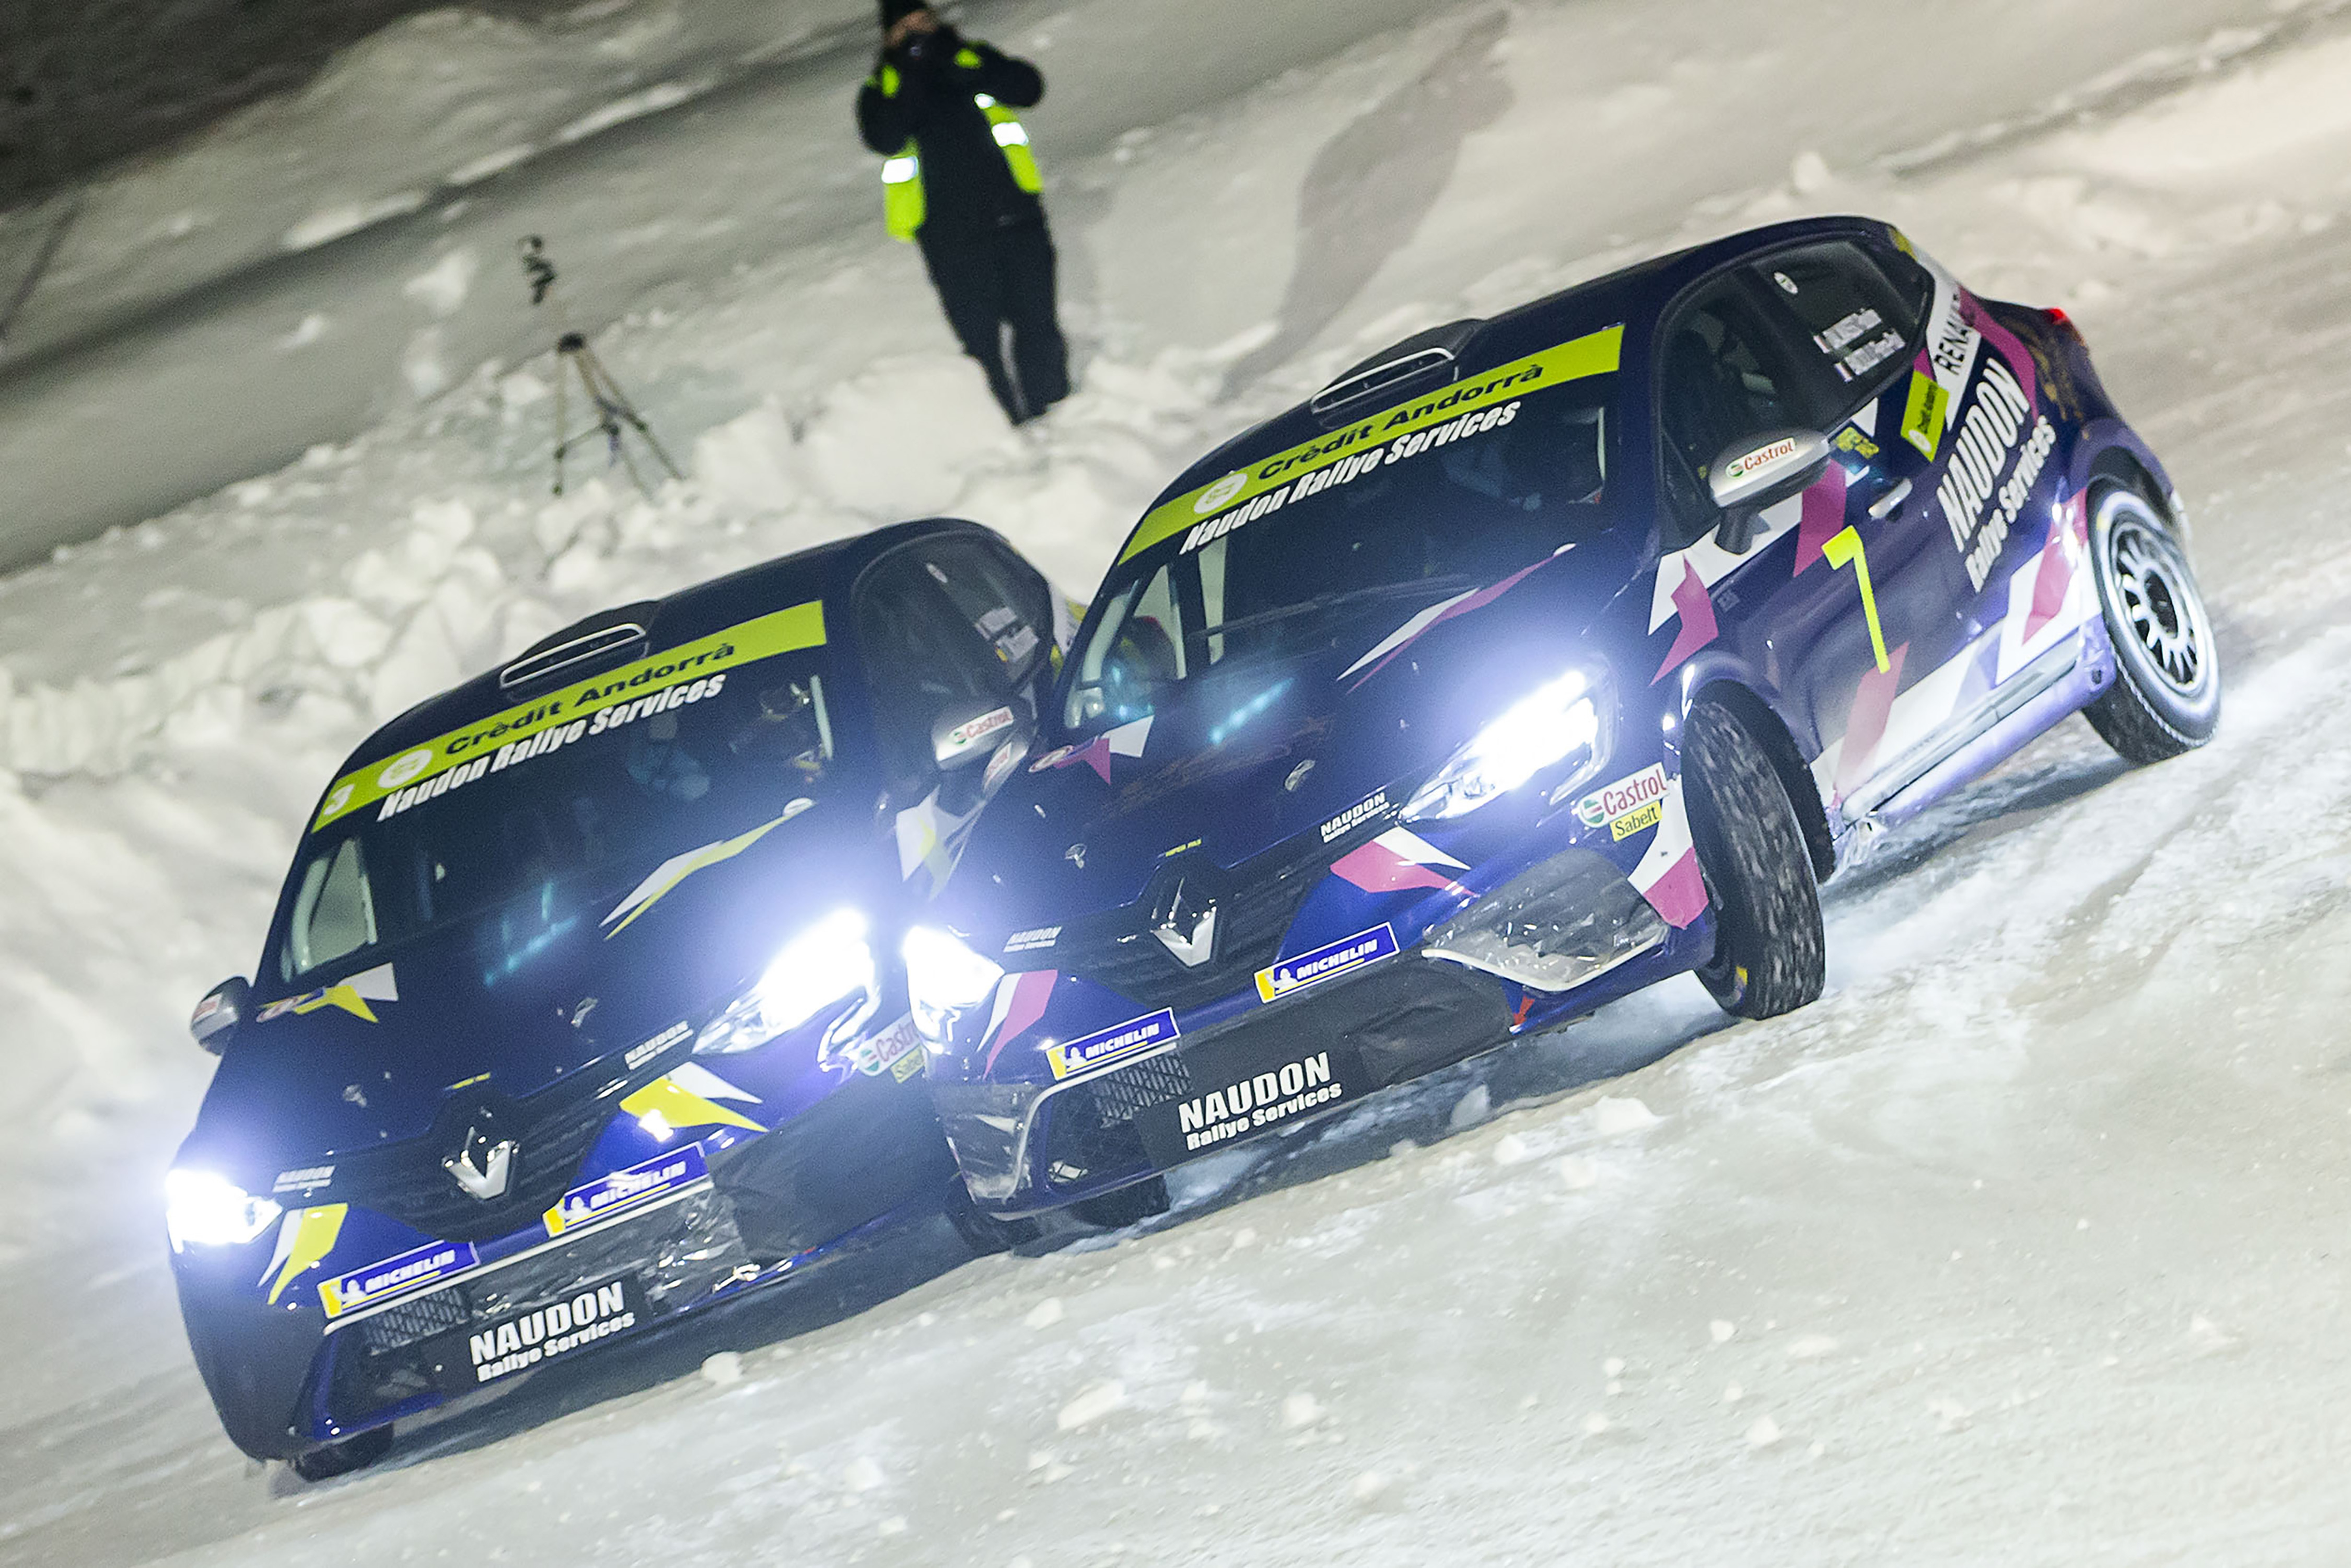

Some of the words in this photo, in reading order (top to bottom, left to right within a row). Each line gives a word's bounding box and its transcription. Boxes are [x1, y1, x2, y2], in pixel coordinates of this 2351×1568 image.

[1259, 425, 1373, 479] Crèdit
[1383, 364, 1543, 431] Andorrà
[1744, 441, 1794, 470] Castrol
[1937, 357, 2030, 552] NAUDON
[1179, 486, 1290, 555] Naudon
[1288, 448, 1384, 504] Rallye
[1384, 401, 1521, 464] Services
[1999, 415, 2056, 524] Services
[446, 701, 563, 754] Crèdit
[575, 643, 735, 707] Andorrà
[376, 756, 490, 822] Naudon
[490, 719, 587, 773] Rallye
[589, 674, 726, 735] Services
[1321, 792, 1386, 837] NAUDON
[1603, 769, 1667, 816] Castrol
[1615, 806, 1658, 837] Sabelt
[1296, 939, 1377, 980] MICHELIN
[1085, 1023, 1160, 1059] MICHELIN
[1179, 1052, 1331, 1133] NAUDON
[1186, 1117, 1250, 1151] Rallye
[1252, 1083, 1342, 1126] Services
[590, 1160, 686, 1210] MICHELIN
[366, 1249, 455, 1294] MICHELIN
[470, 1282, 624, 1365] NAUDON
[477, 1347, 542, 1383] Rallye
[544, 1312, 635, 1357] Services
